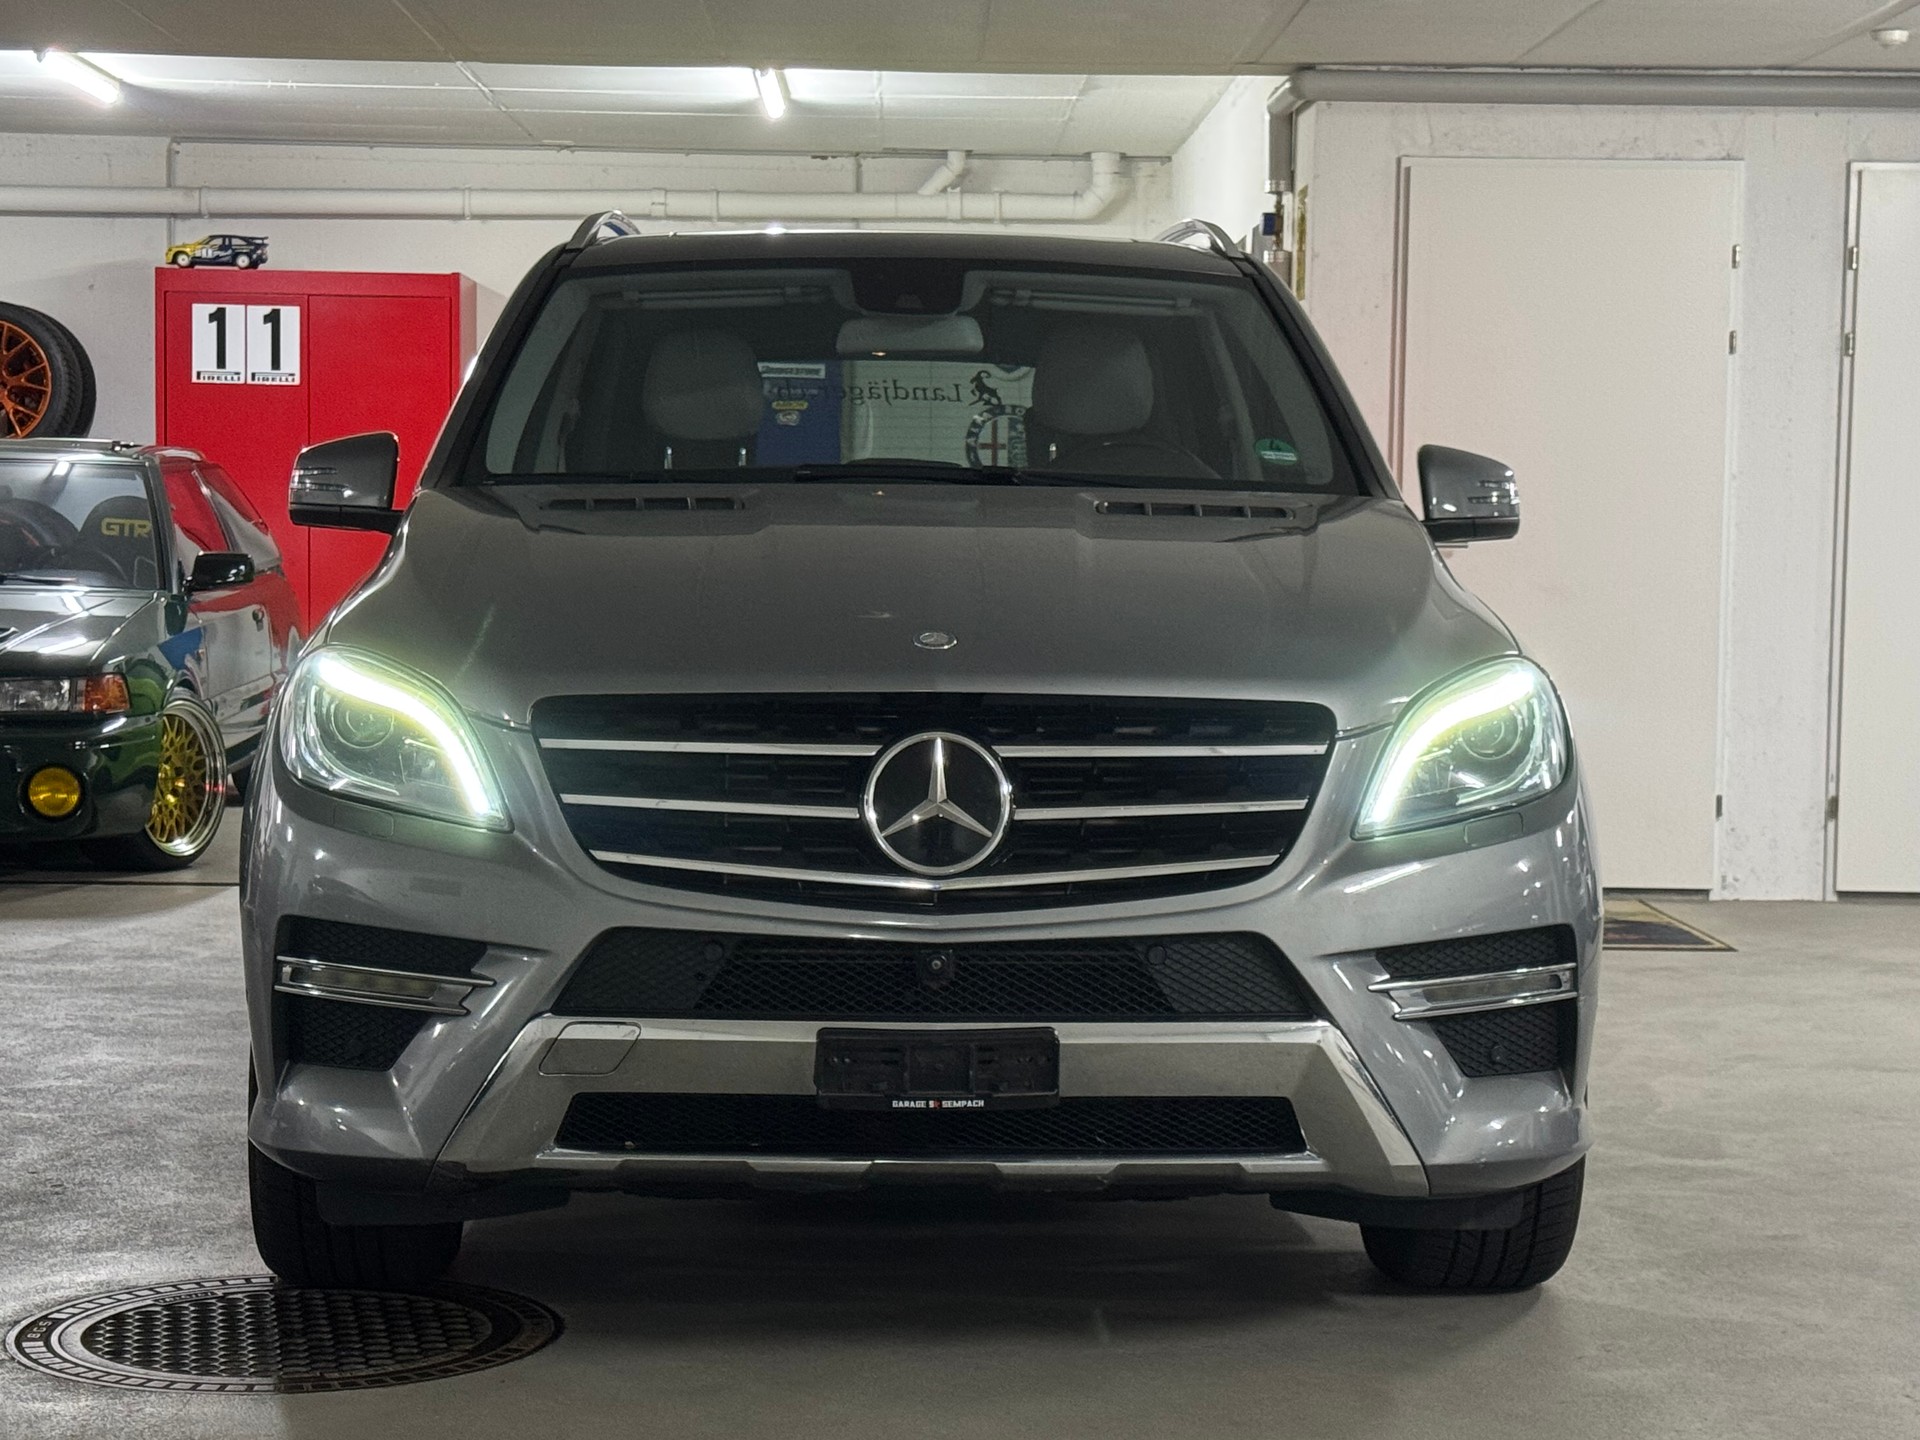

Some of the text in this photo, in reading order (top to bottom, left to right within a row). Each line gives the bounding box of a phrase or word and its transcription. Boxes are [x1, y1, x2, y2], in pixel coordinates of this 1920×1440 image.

[196, 371, 241, 382] PIRELLI
[101, 517, 151, 537] GTR
[892, 1100, 926, 1108] GARAGE
[942, 1099, 985, 1108] SEMPACH
